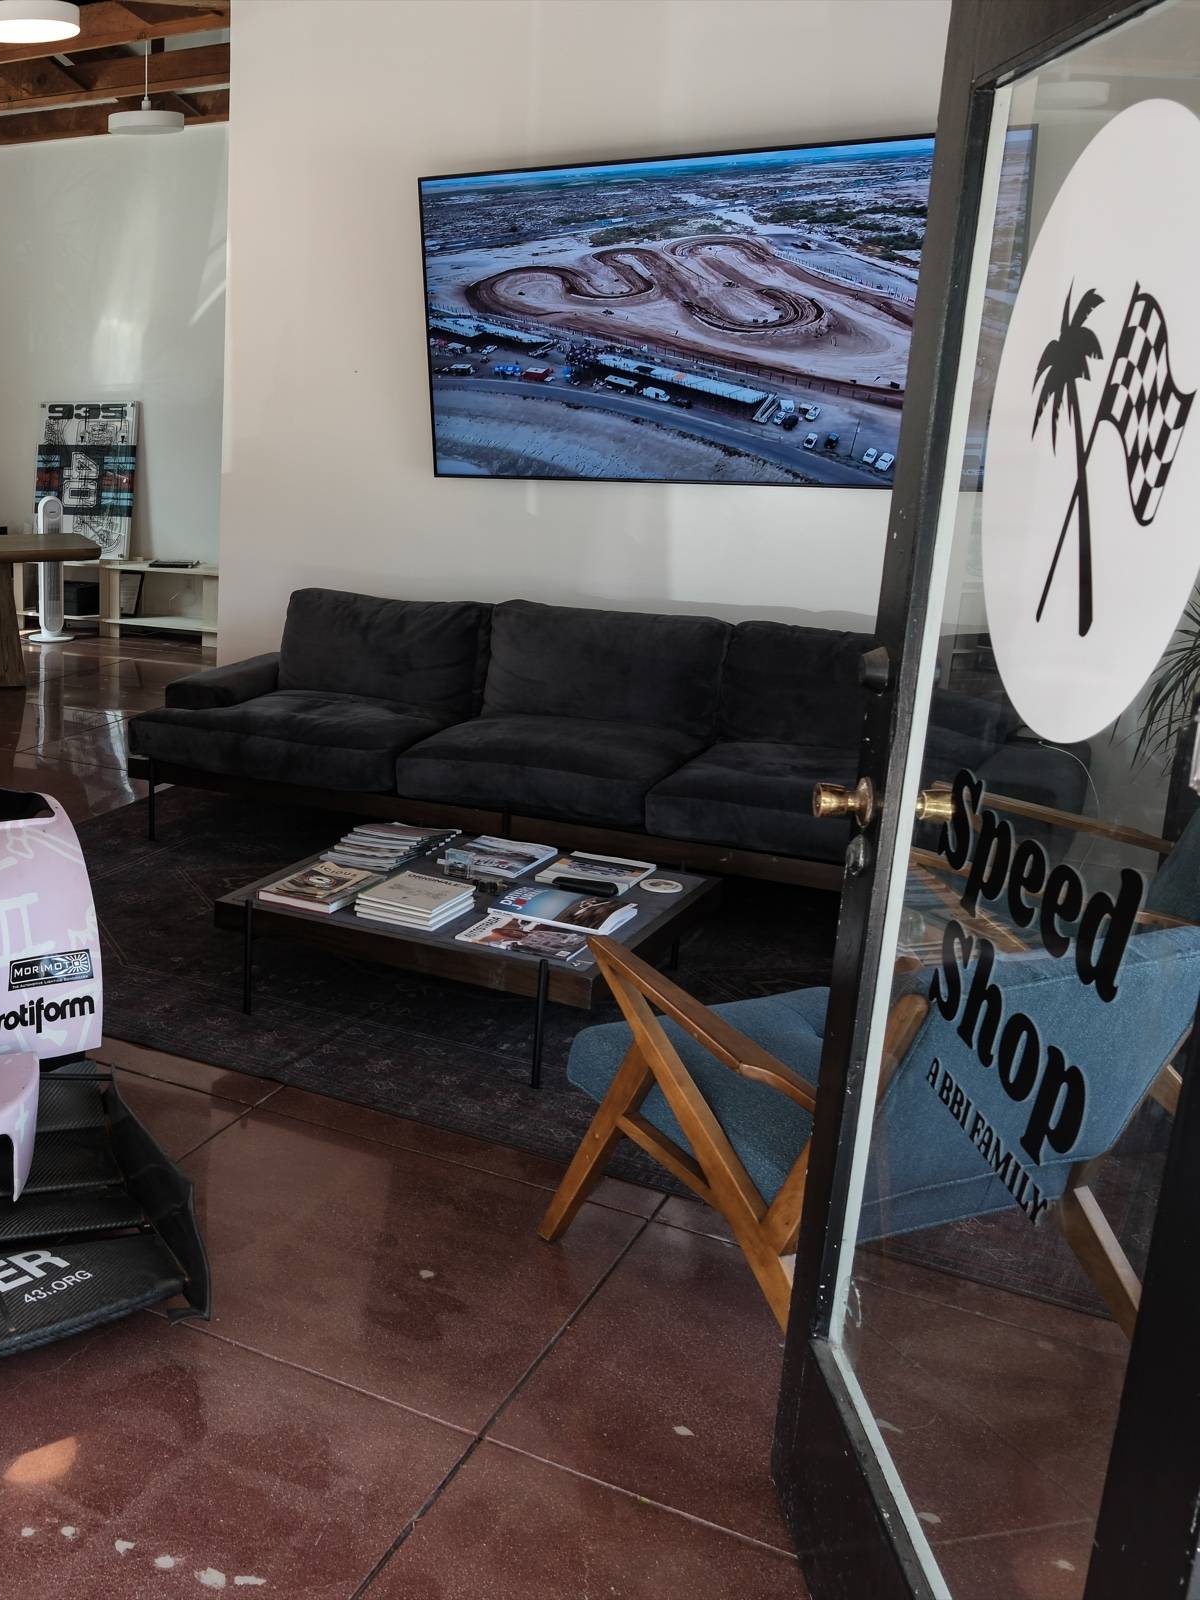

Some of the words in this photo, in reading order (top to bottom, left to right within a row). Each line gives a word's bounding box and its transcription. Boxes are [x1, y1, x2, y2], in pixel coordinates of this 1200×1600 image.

[48, 404, 128, 420] 935
[937, 769, 1145, 1003] Speed
[925, 1057, 938, 1089] A
[938, 1072, 971, 1133] BBI
[970, 1111, 1052, 1227] FAMILY
[928, 921, 1086, 1167] Shop
